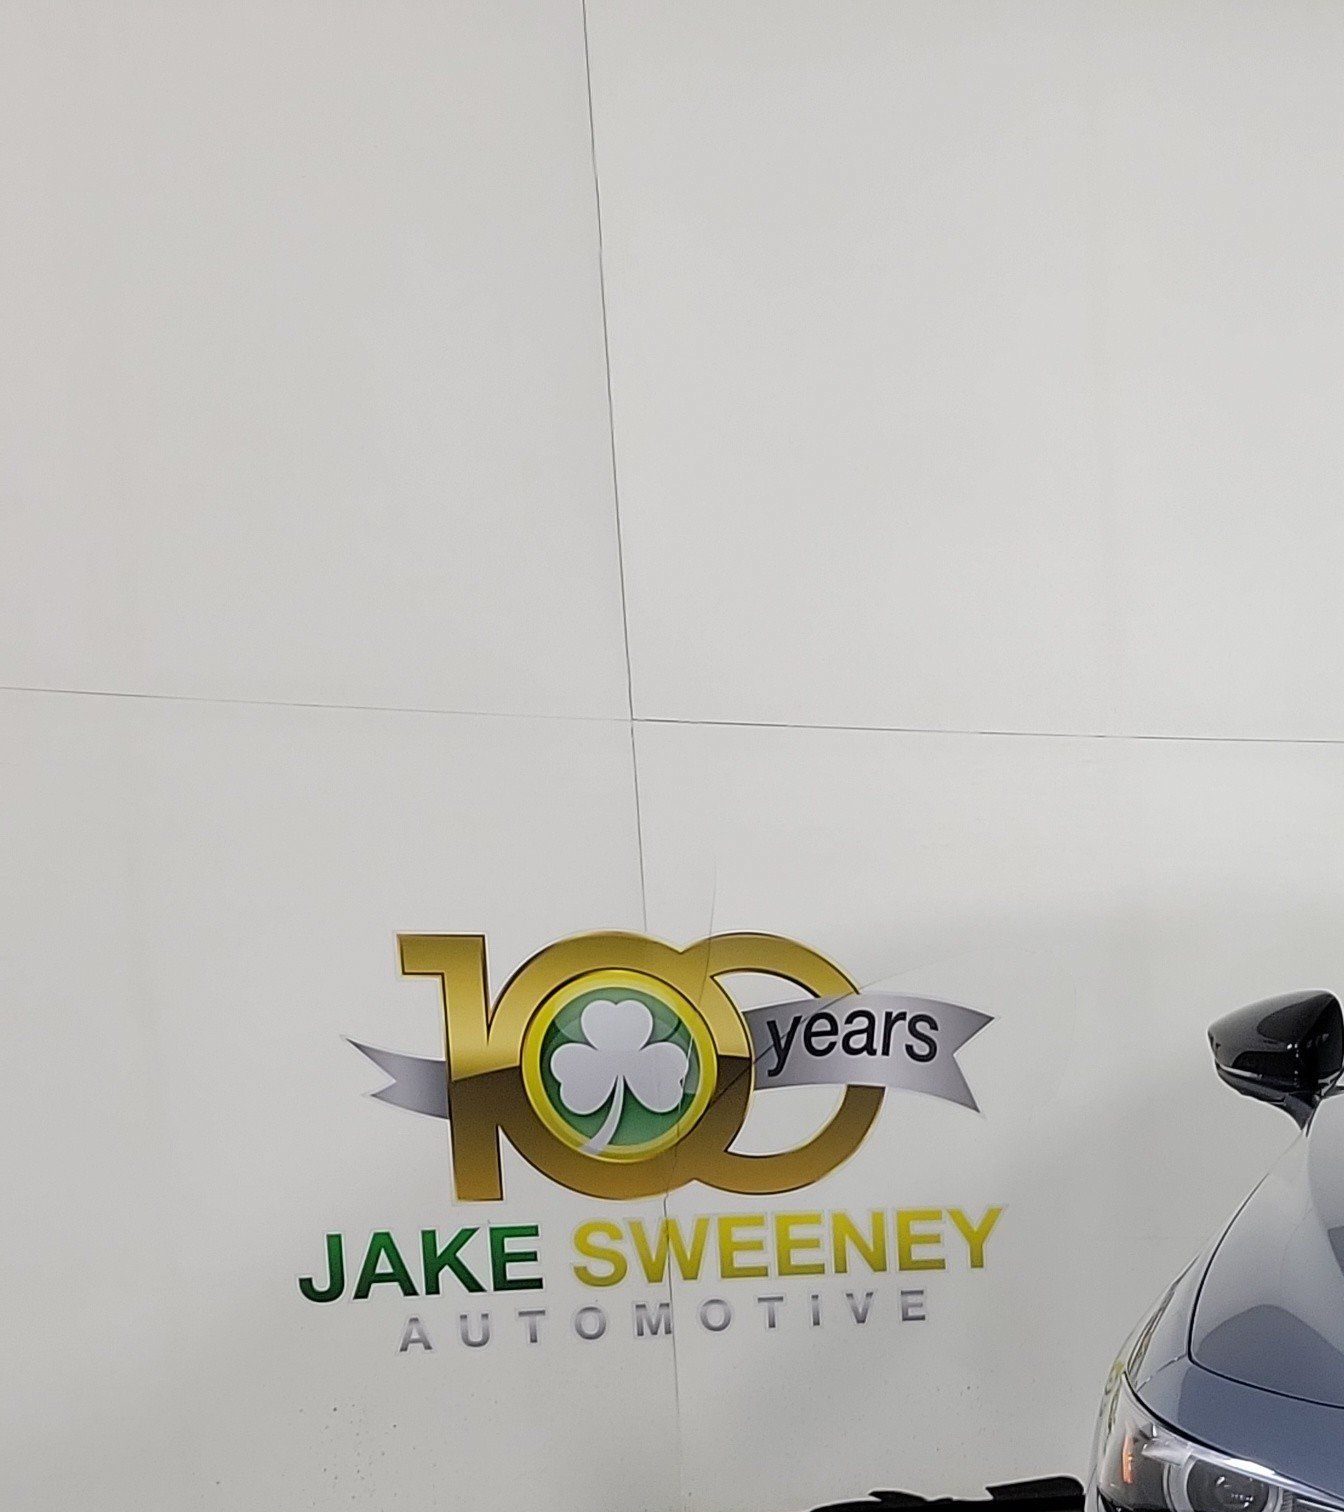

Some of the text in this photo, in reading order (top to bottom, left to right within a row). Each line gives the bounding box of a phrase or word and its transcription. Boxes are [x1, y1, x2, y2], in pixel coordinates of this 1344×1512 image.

[399, 931, 940, 1201] 100 years
[299, 1207, 1004, 1303] JAKE SWEENEY
[400, 1289, 927, 1353] AUTOMOTIVE
